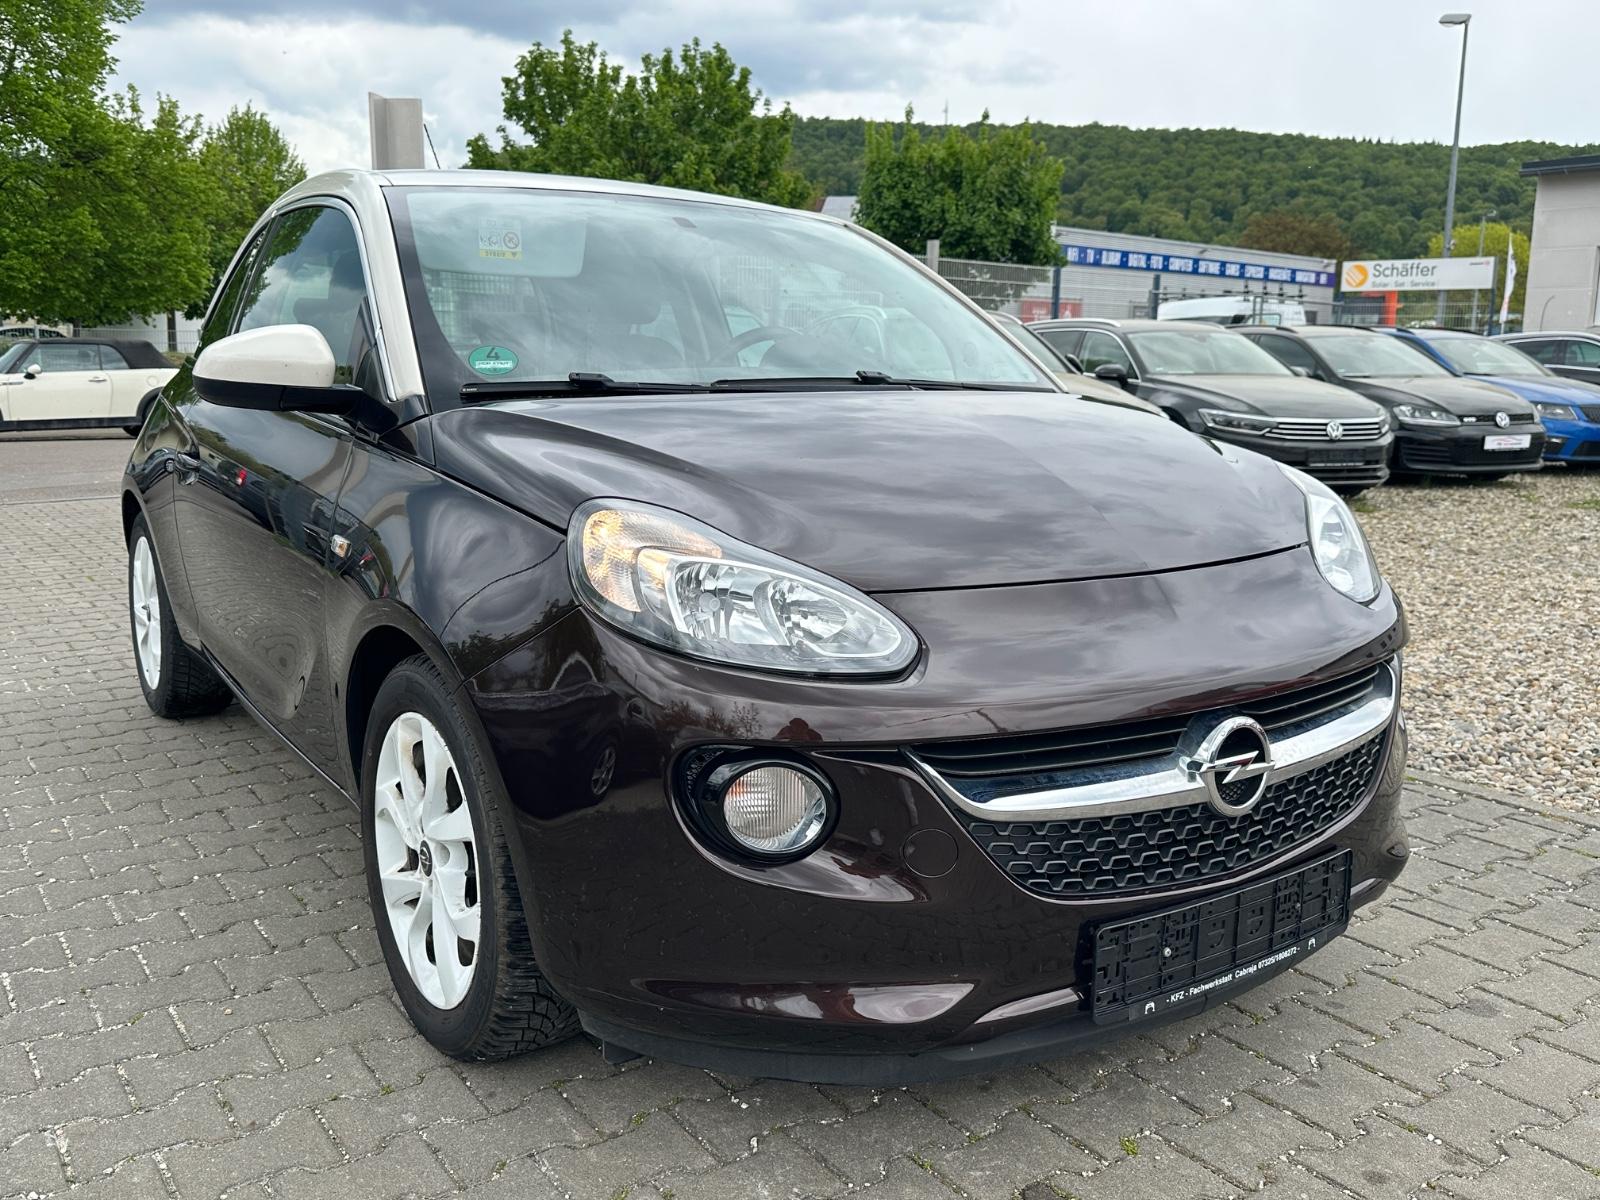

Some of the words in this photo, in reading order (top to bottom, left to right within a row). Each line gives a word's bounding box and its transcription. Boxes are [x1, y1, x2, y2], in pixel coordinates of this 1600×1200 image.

[1168, 257, 1193, 272] COMPUTER
[1372, 263, 1437, 278] Schäffer
[1372, 280, 1389, 288] Solar
[1410, 280, 1436, 288] Service
[486, 347, 500, 360] 4
[1170, 991, 1185, 1003] KFZ
[1189, 973, 1233, 996] Fachwerkstatt
